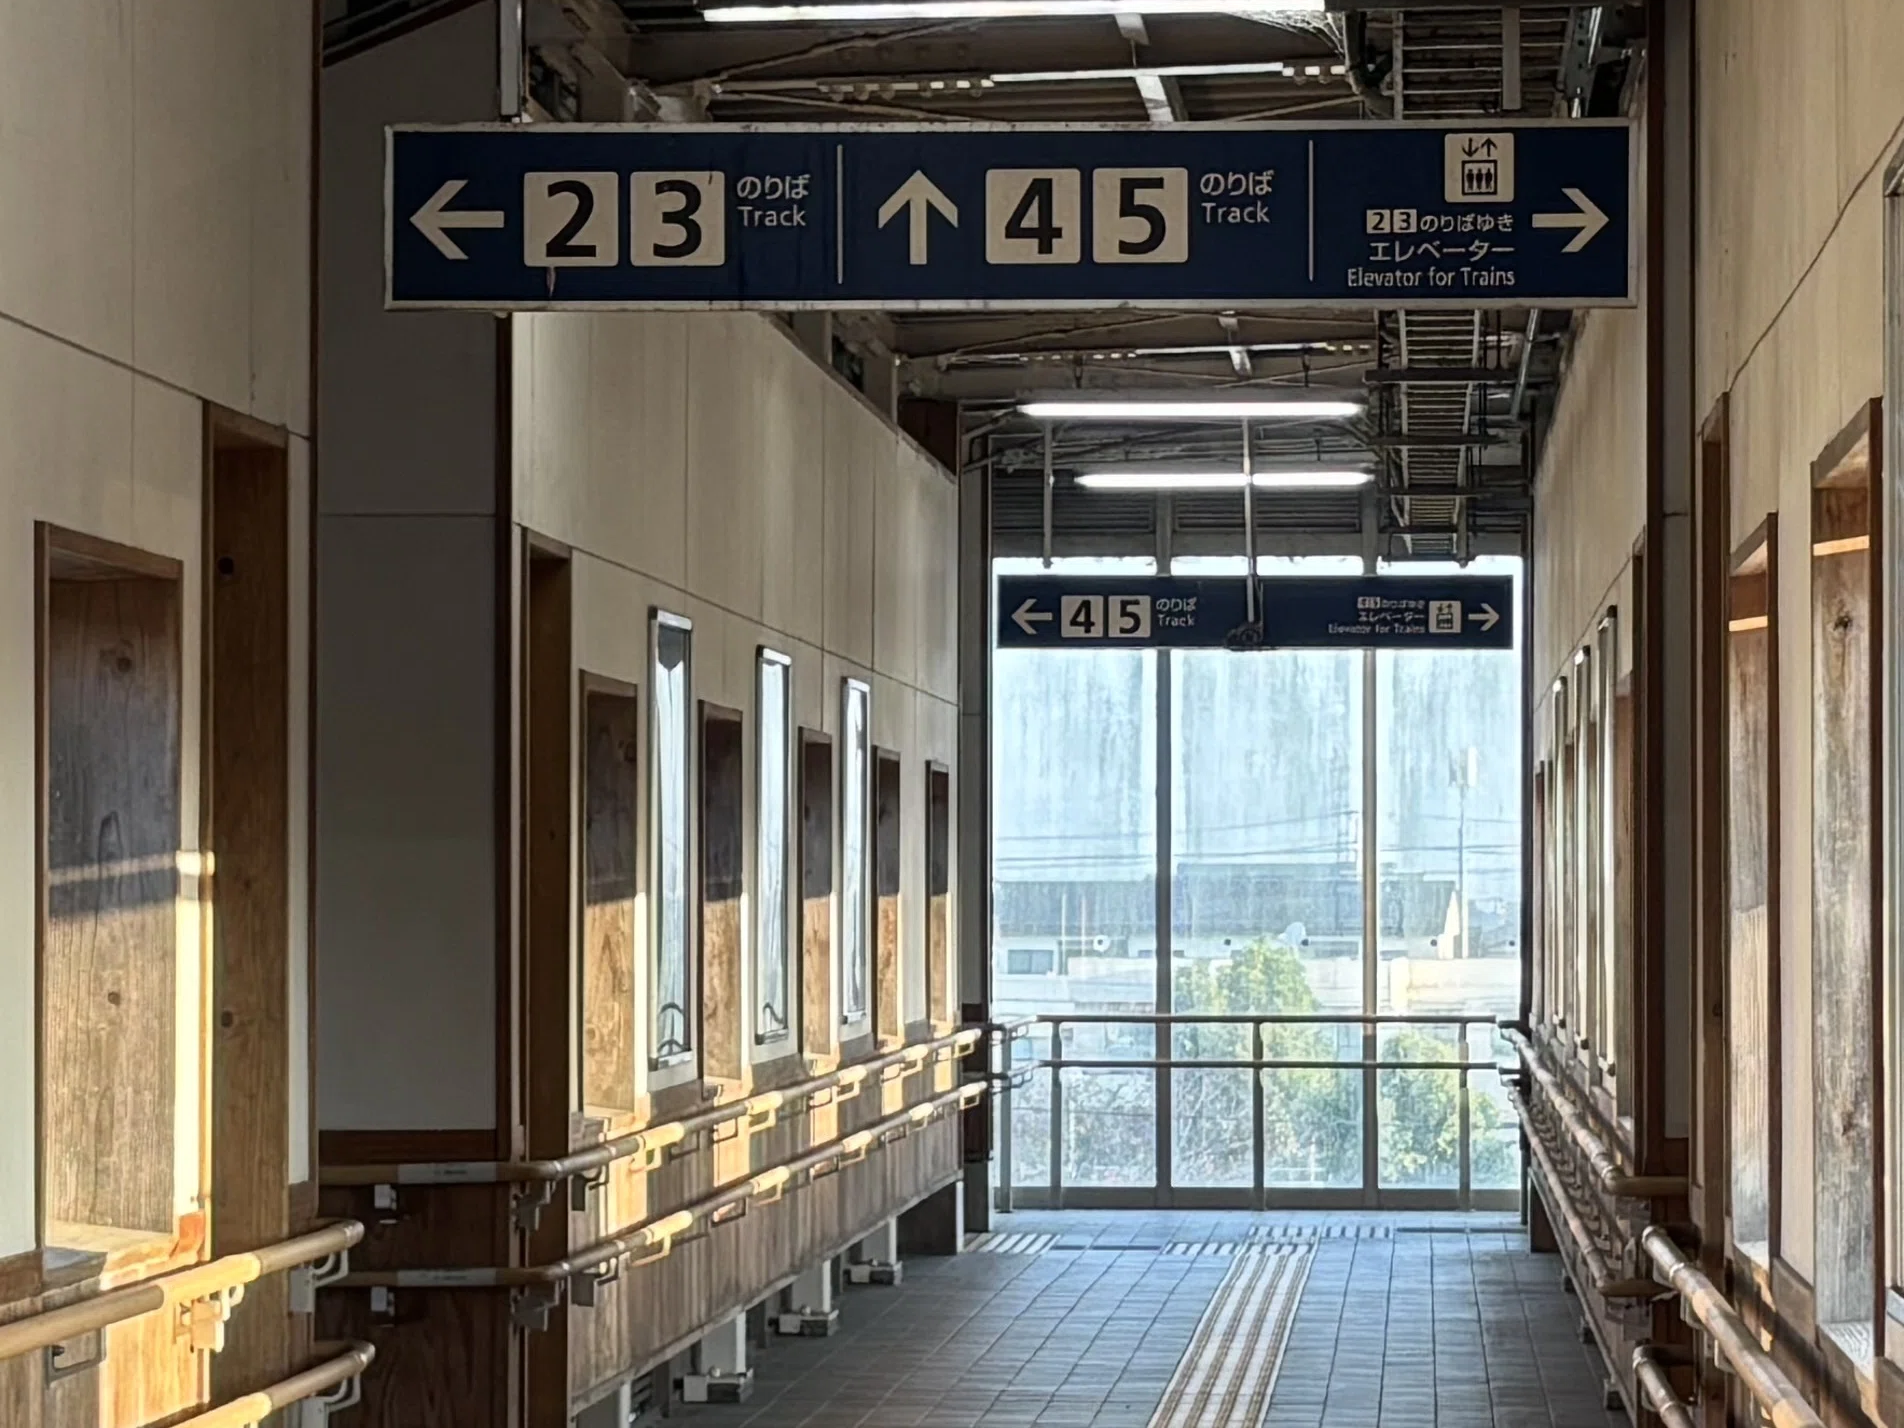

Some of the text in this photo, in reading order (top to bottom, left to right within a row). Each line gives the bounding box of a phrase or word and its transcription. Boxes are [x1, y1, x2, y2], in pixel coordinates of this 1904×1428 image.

[546, 174, 811, 258] 2 3 のりば
[737, 205, 807, 227] Track
[1005, 171, 1275, 255] 4 5 のりば
[1201, 201, 1271, 223] Track
[1419, 214, 1514, 232] のりばゆき
[1369, 240, 1516, 262] エレベーター
[1348, 266, 1516, 287] Elevator for Trains
[1069, 600, 1095, 634] 4
[1119, 599, 1142, 634] 5
[1156, 614, 1195, 628] Track
